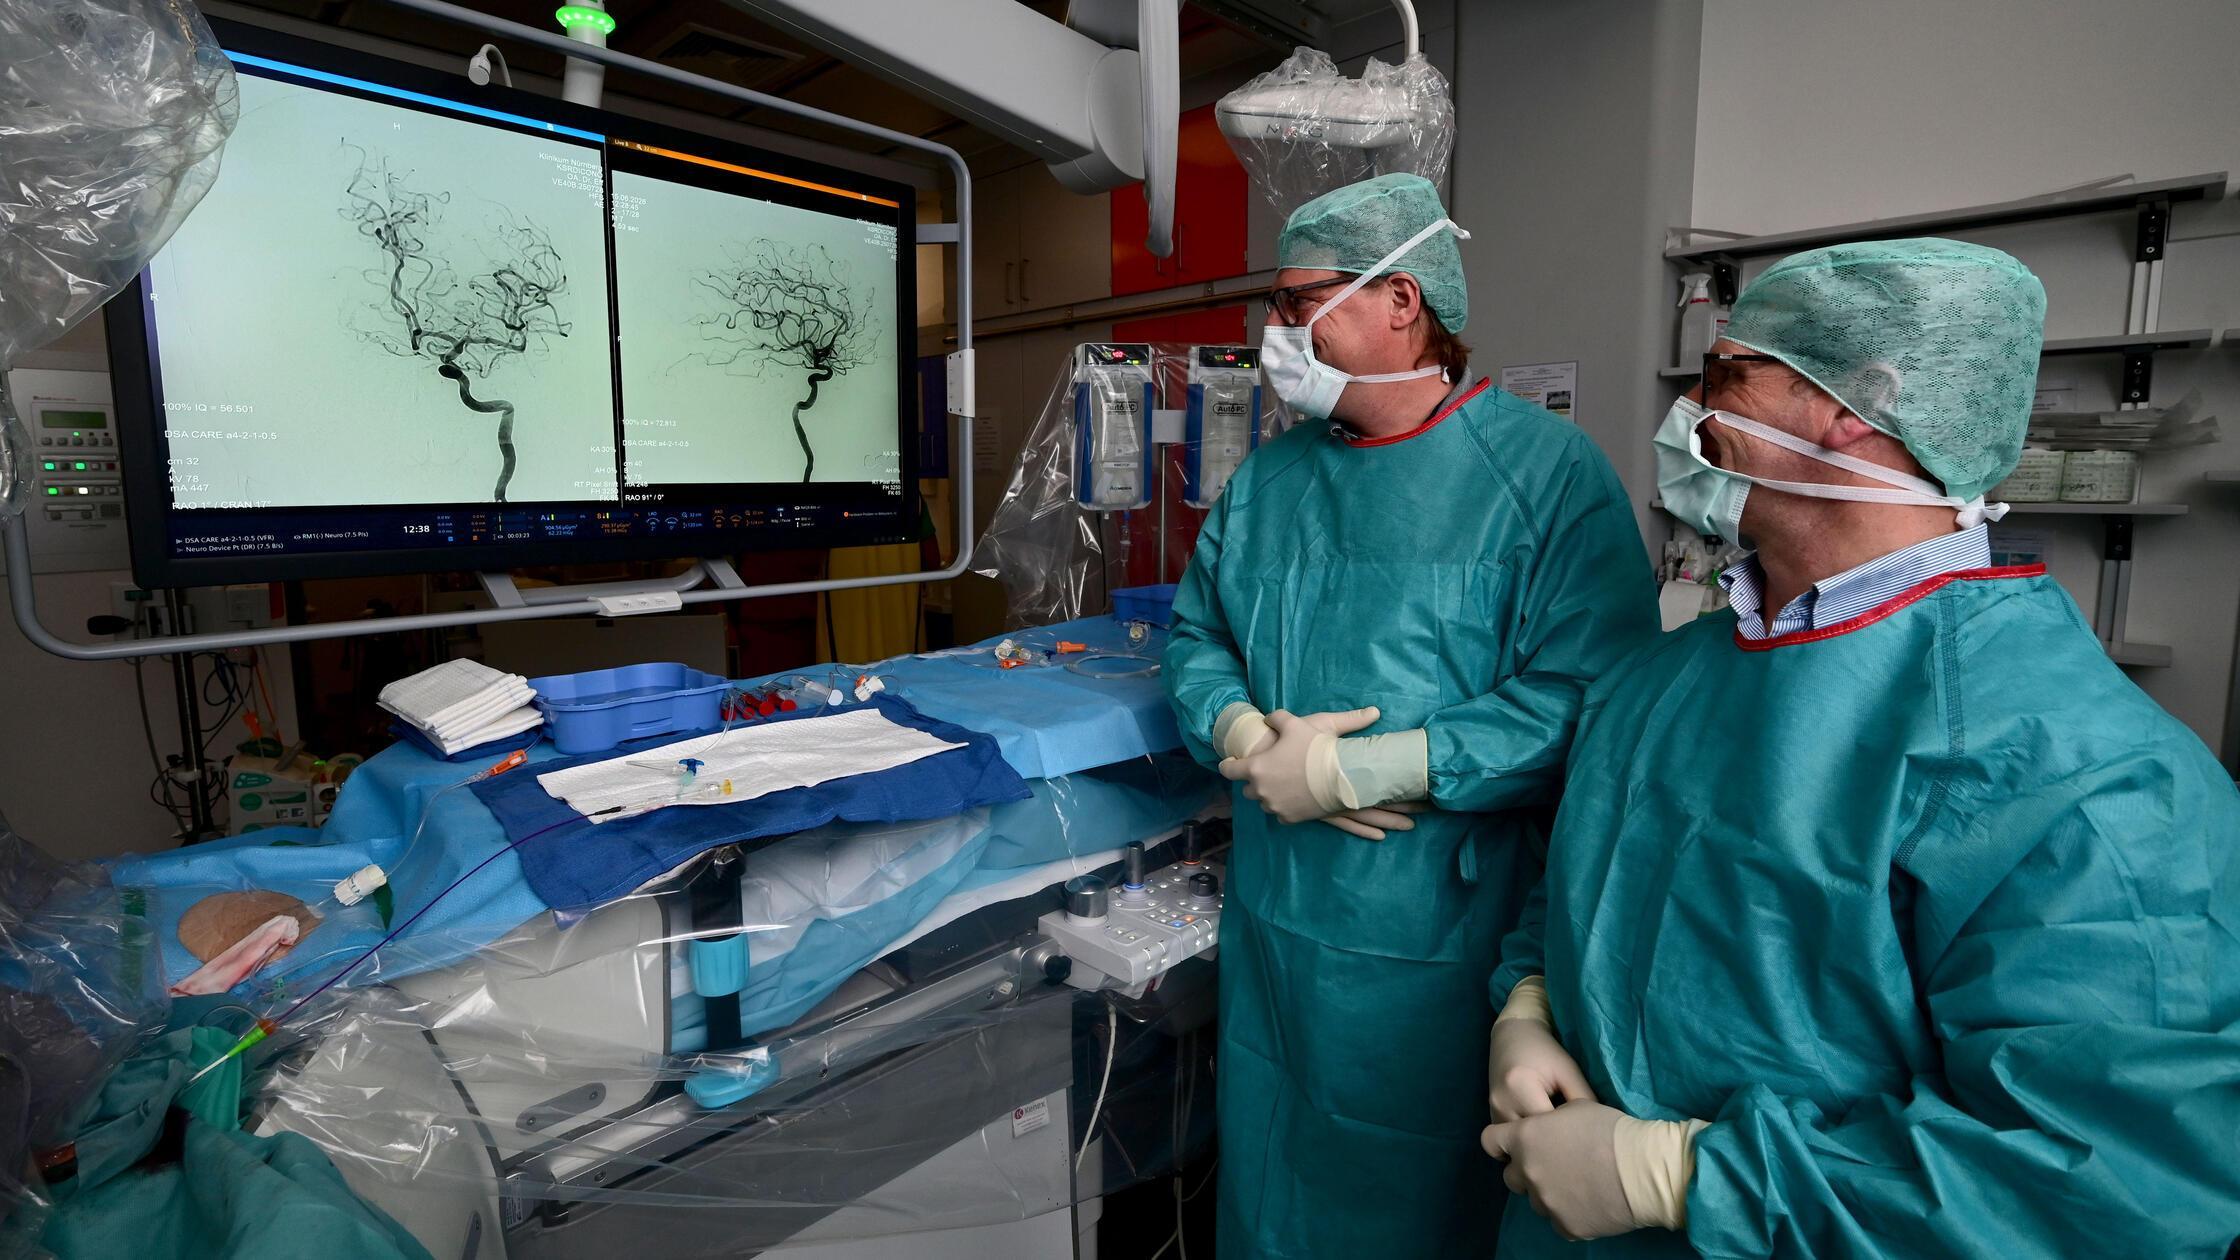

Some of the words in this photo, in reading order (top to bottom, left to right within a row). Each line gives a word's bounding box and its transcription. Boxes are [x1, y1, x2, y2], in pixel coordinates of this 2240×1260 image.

[393, 121, 401, 131] H
[539, 151, 569, 163] Klinikum
[570, 159, 603, 172] Nürnberg
[162, 402, 192, 412] 100%
[195, 403, 208, 413] IQ
[1217, 403, 1235, 413] Auto
[164, 430, 189, 439] DSA
[191, 430, 224, 439] CARE
[226, 431, 278, 440] a4-2-1-0.5
[167, 458, 183, 466] cm
[186, 457, 200, 466] 32
[168, 466, 176, 475] A
[169, 475, 183, 484] kV
[170, 484, 189, 493] mA
[190, 484, 209, 492] 447
[172, 501, 198, 510] RAO
[220, 500, 253, 509] CRAN
[254, 500, 272, 508] 17°
[403, 525, 430, 533] 12:38
[325, 531, 344, 539] Neuro
